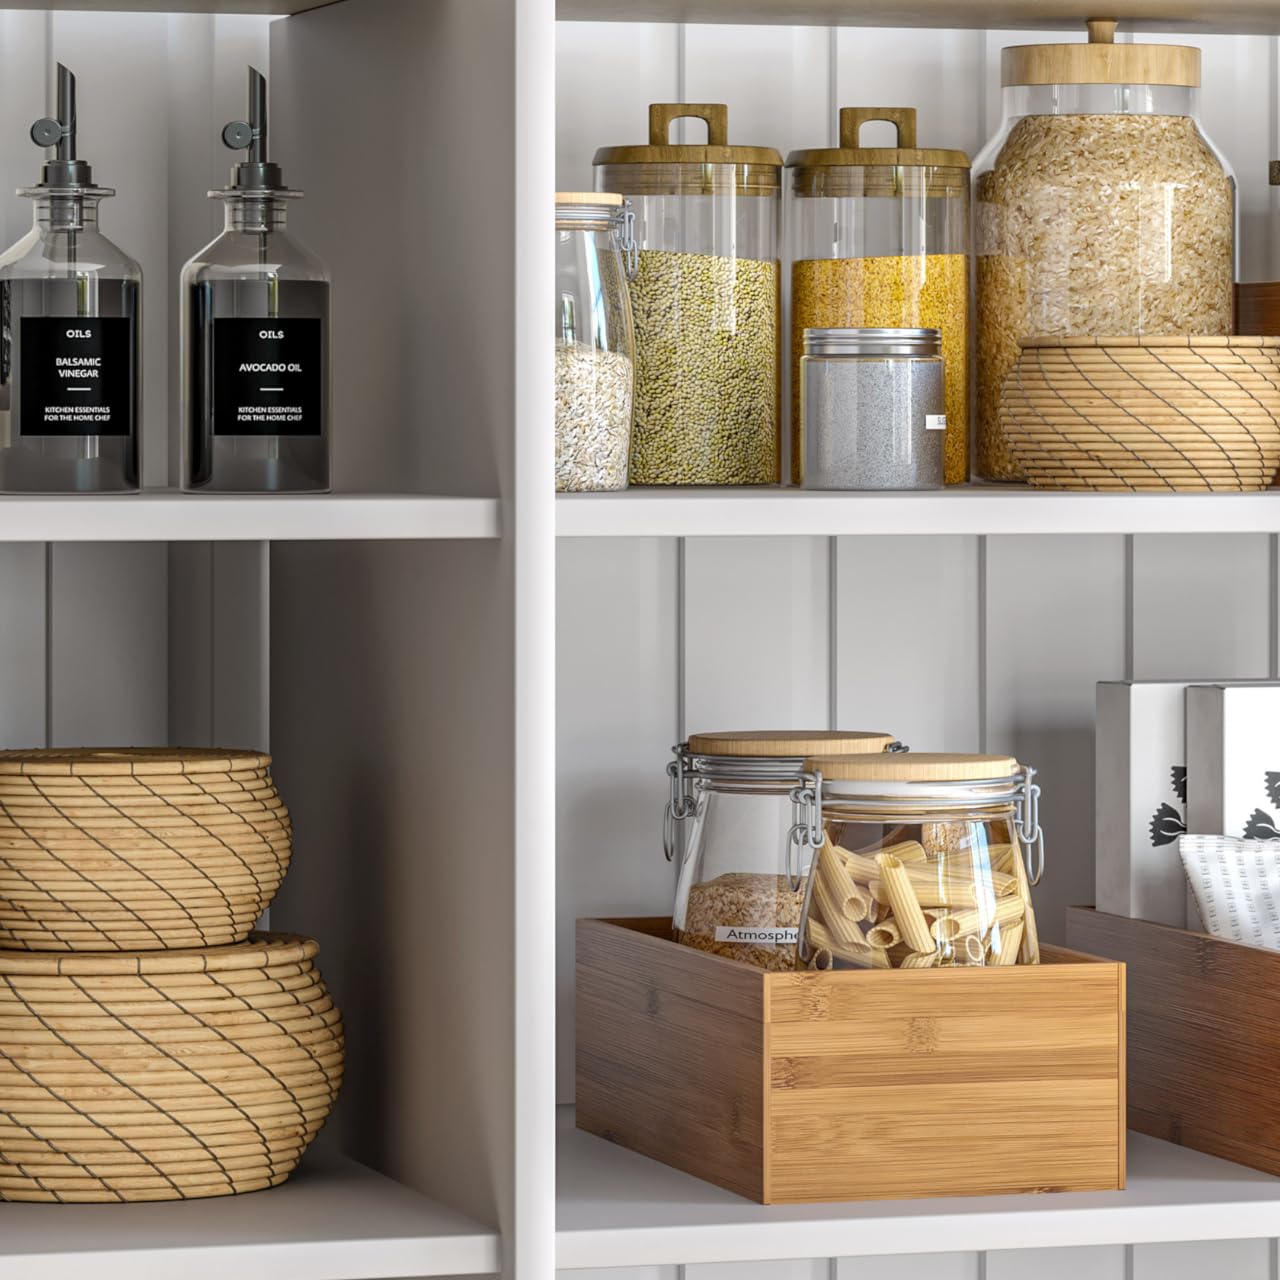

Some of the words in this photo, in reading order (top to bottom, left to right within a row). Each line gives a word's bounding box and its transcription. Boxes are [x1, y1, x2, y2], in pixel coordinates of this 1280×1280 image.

[66, 330, 92, 338] OILS
[258, 330, 285, 339] OILS
[55, 358, 102, 366] BALSAMIC
[239, 363, 287, 372] AVOCADO
[287, 363, 302, 372] OIL
[58, 369, 99, 378] VINEGAR
